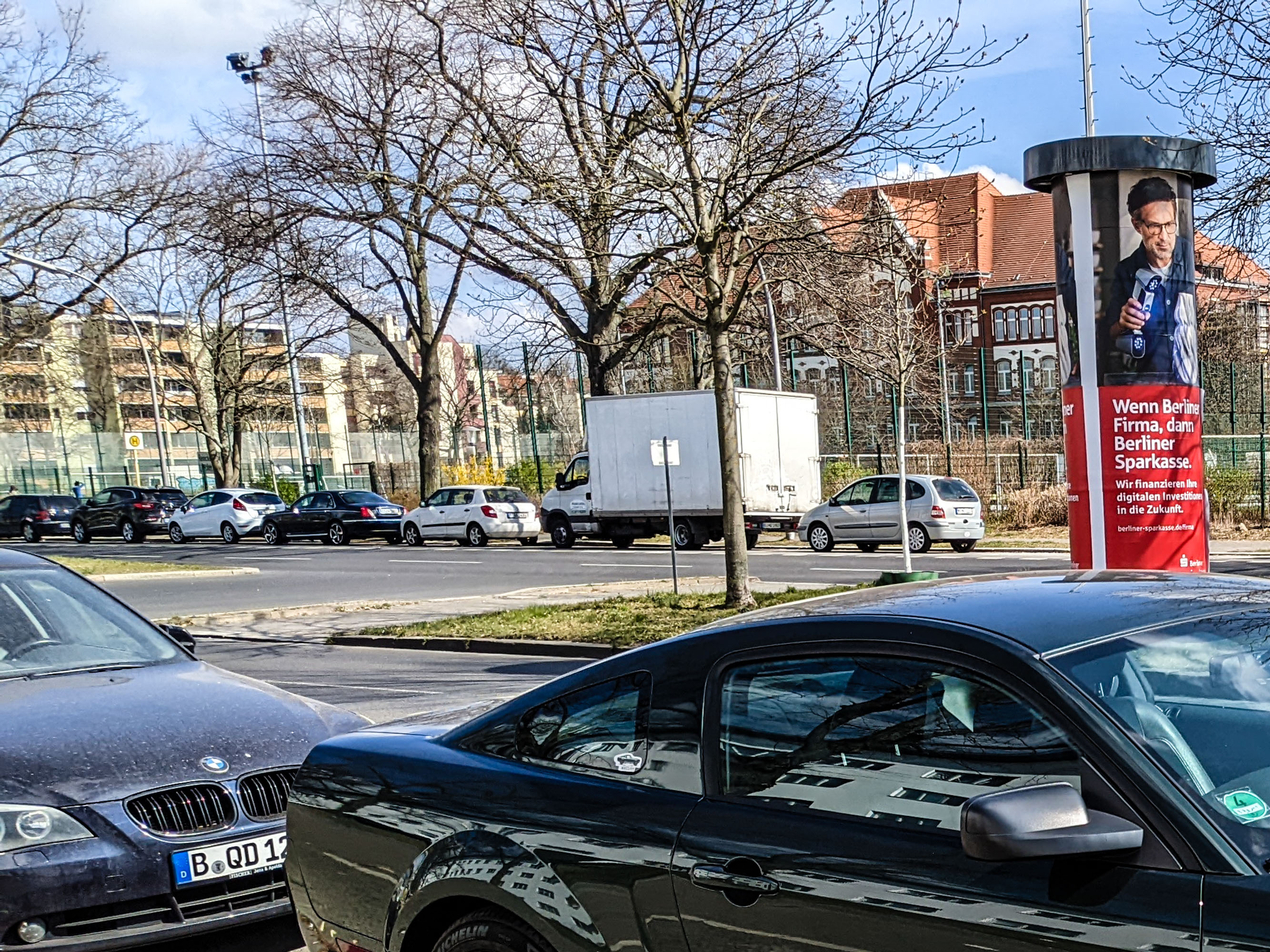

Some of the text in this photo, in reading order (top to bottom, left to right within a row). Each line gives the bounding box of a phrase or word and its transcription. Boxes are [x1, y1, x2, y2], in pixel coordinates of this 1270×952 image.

[1112, 398, 1200, 414] Wenn Berliner
[1113, 416, 1194, 434] Firma, dann
[1114, 435, 1176, 451] Berliner
[1115, 454, 1192, 473] Sparkasse.
[1115, 478, 1197, 489] Wir finanzieren Ihre
[1116, 492, 1161, 504] digitalen
[1117, 504, 1184, 515] in die Zukunft.
[1233, 796, 1247, 807] 4
[191, 853, 209, 877] B
[226, 842, 259, 869] QD
[180, 871, 188, 879] D
